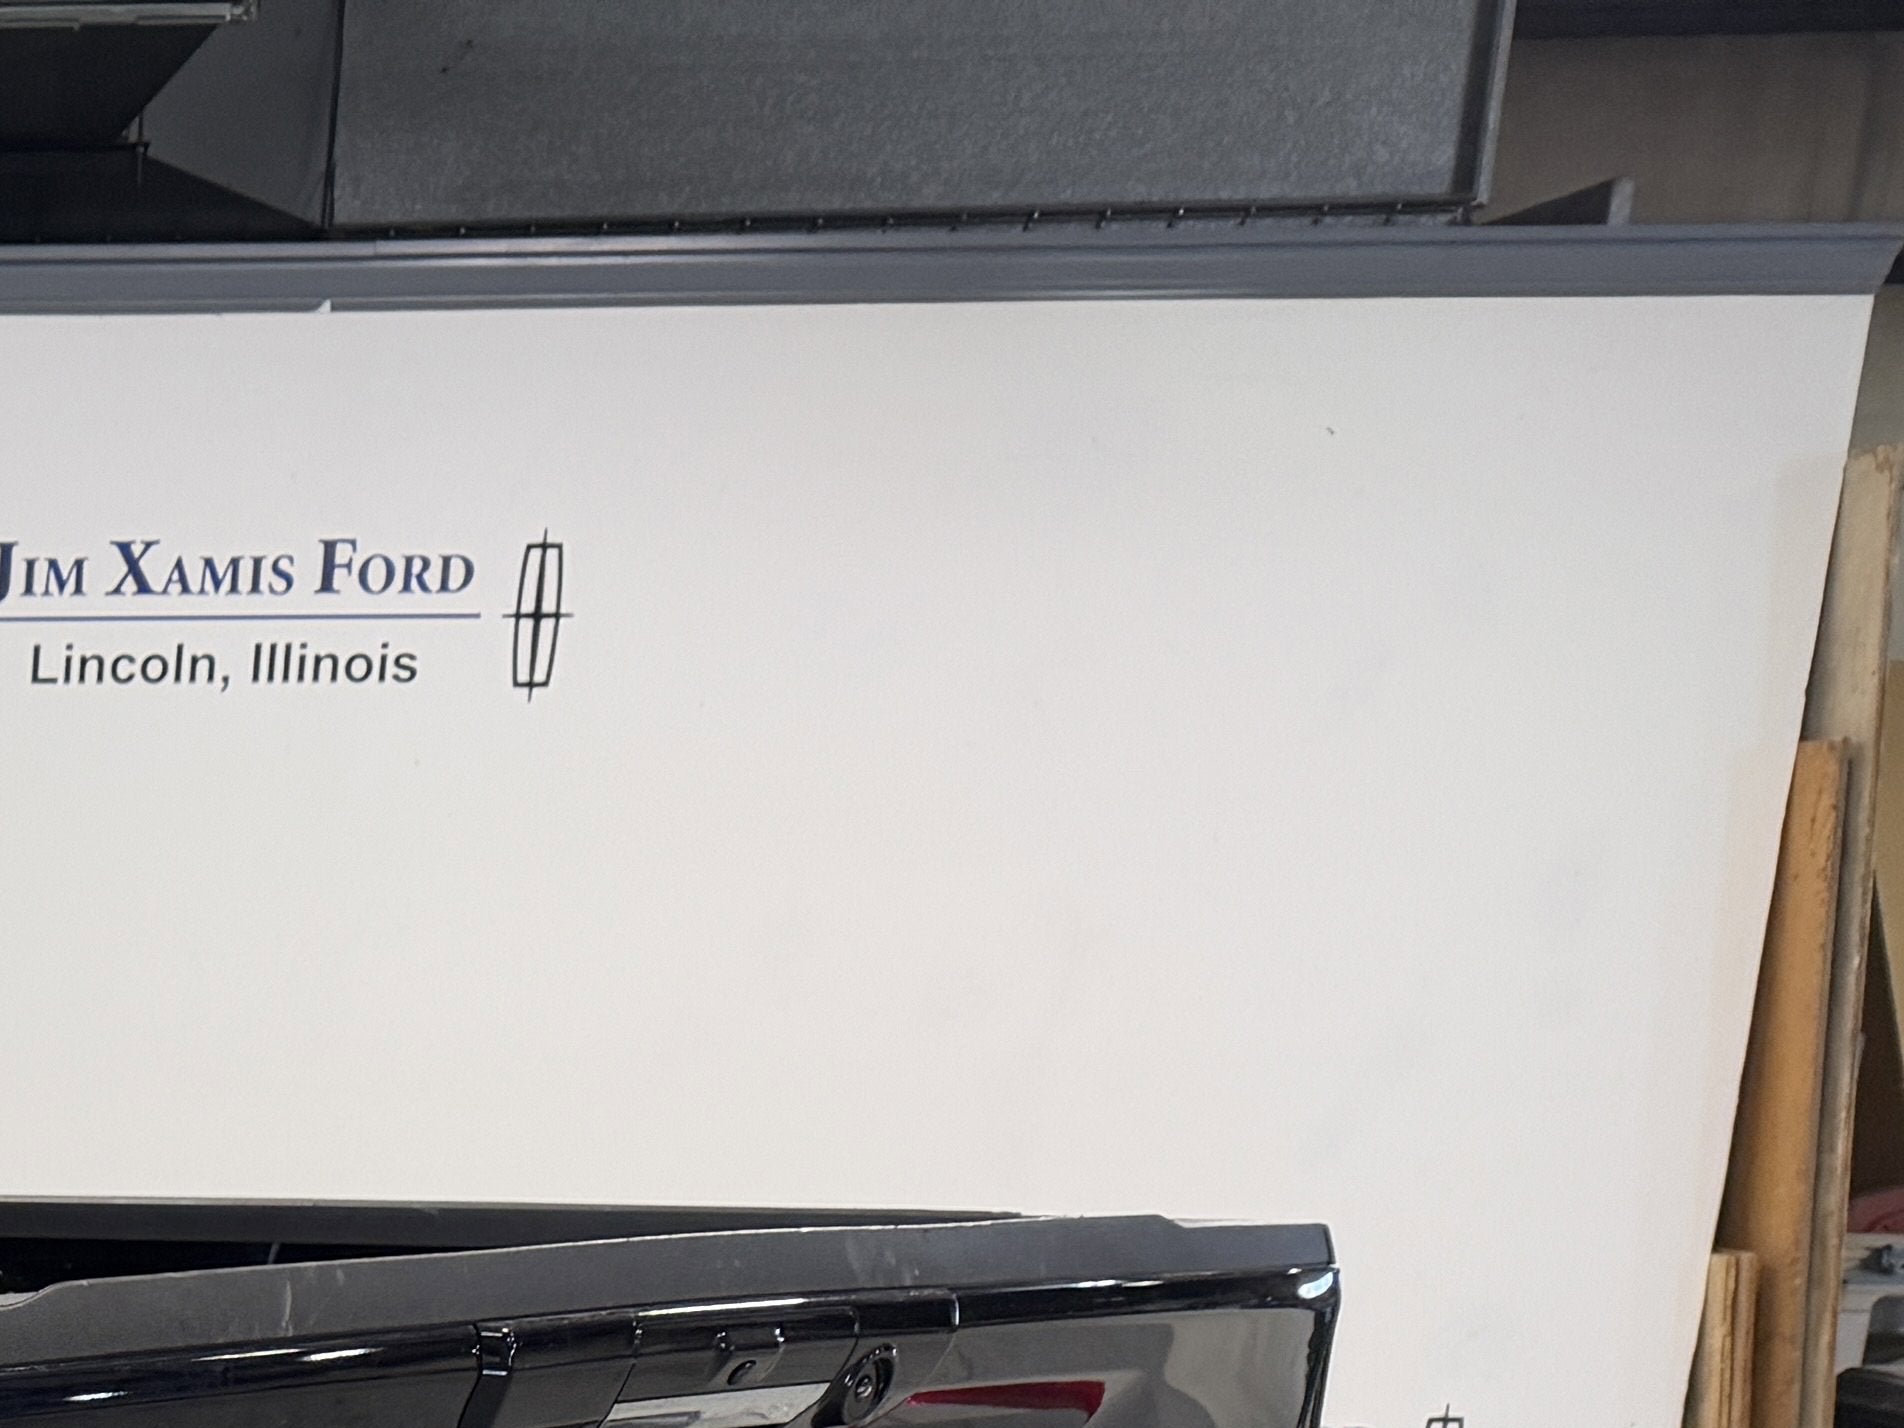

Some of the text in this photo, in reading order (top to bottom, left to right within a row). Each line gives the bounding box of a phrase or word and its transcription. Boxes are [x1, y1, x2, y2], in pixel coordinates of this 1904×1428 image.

[104, 539, 296, 597] XAMIS
[313, 538, 476, 595] FORD
[30, 641, 419, 693] Lincoln, Illinois
